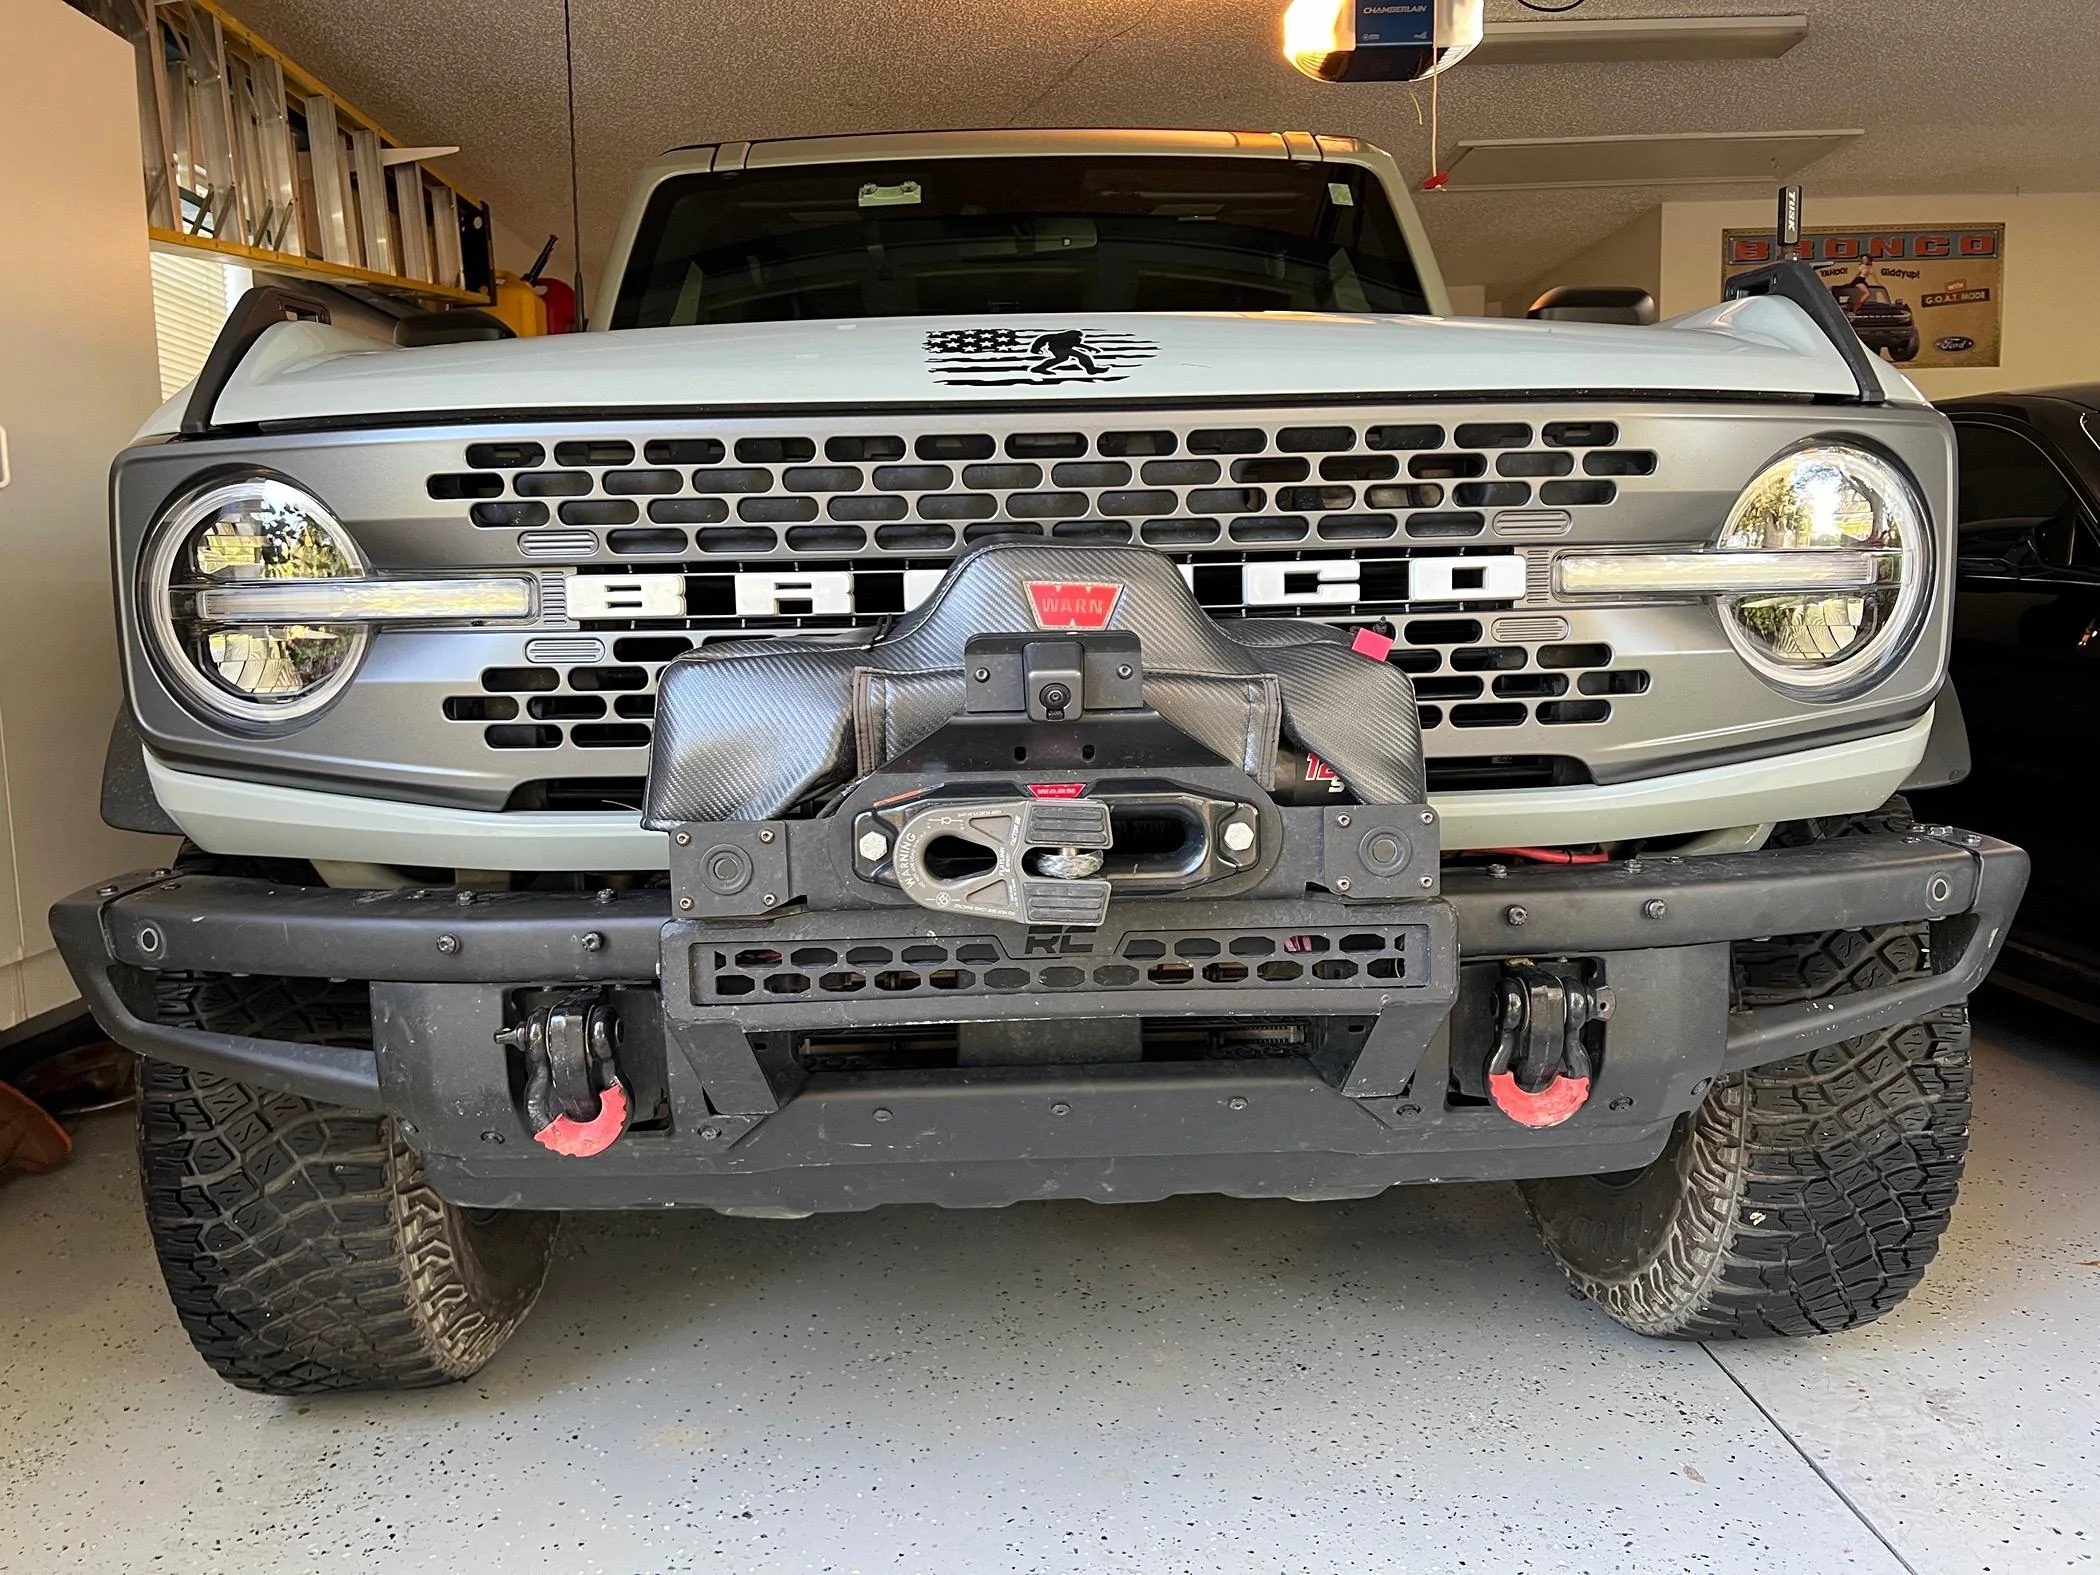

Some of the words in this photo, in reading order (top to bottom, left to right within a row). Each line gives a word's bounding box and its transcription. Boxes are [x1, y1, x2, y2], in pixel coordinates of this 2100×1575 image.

[1363, 5, 1427, 14] CHAMBERLAIN
[1788, 191, 1796, 232] TUSK
[1820, 267, 1848, 278] YAHOO!
[1881, 267, 1920, 279] Giddyup!
[1961, 291, 1986, 301] MODE
[1940, 338, 1966, 349] Ford
[1042, 597, 1103, 615] WARN
[900, 832, 916, 889] WARNING
[1024, 925, 1097, 955] RC
